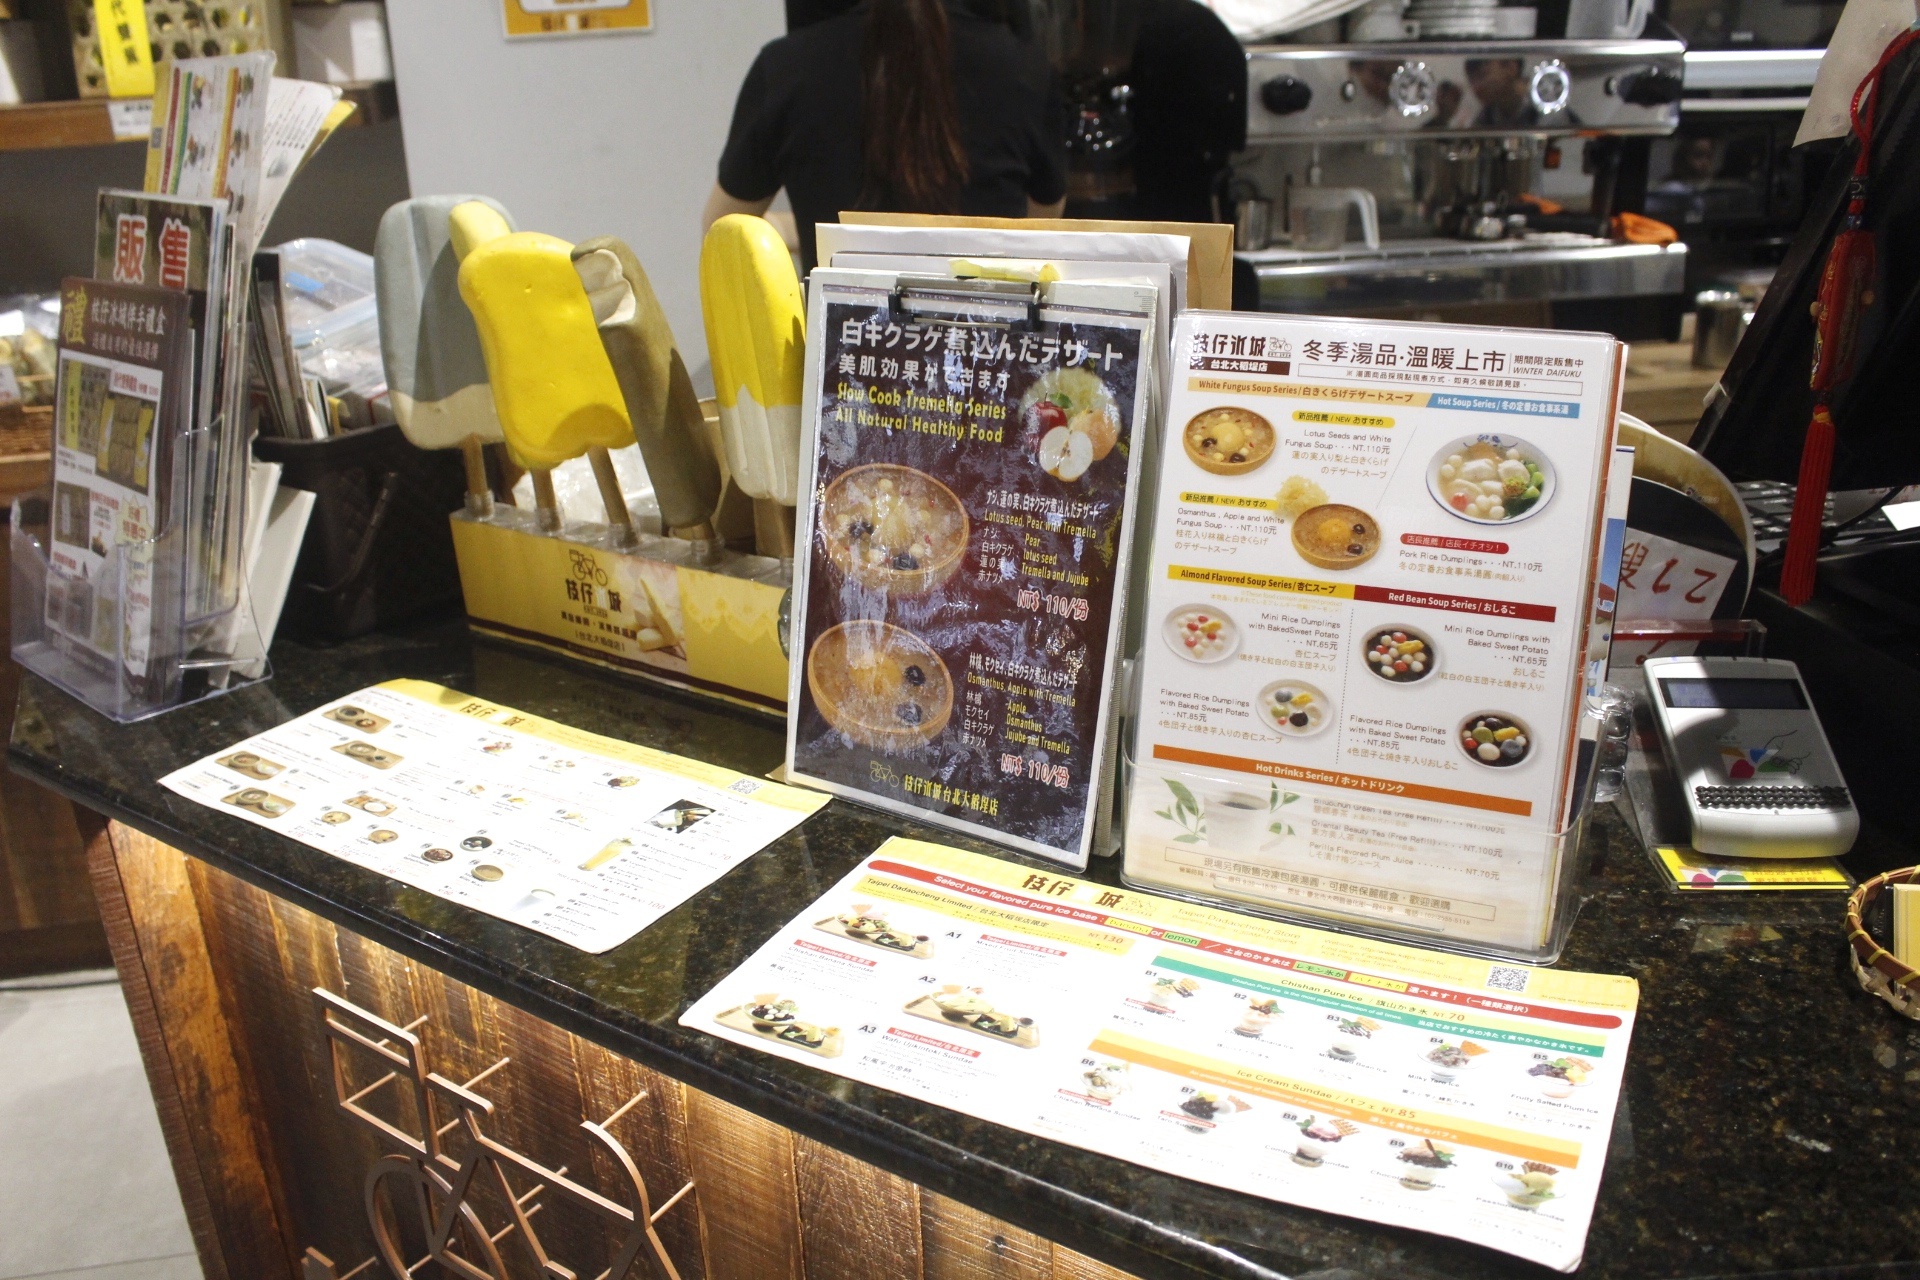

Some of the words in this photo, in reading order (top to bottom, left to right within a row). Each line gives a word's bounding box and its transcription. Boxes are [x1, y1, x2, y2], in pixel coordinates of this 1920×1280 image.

[1513, 367, 1543, 375] WINTER
[1546, 369, 1581, 378] DAIFUKU
[1199, 380, 1222, 390] White
[1223, 382, 1250, 393] Fungus
[1252, 384, 1272, 396] Soup
[1274, 385, 1297, 395] Series
[837, 381, 864, 401] Slow
[868, 385, 901, 405] Cook
[906, 390, 963, 415] Tremella
[968, 398, 1007, 420] Series
[1438, 397, 1451, 405] Hot
[1453, 398, 1471, 408] Soup
[1473, 399, 1495, 408] Series
[835, 407, 853, 422] All
[857, 411, 908, 431] Natural
[912, 416, 964, 442] Healthy
[970, 426, 1003, 443] Food
[1353, 417, 1384, 426] おすすめ
[1285, 439, 1311, 449] Fungus
[1314, 441, 1333, 450] Soup
[1304, 430, 1326, 438] Lotus
[1328, 431, 1350, 440] Seeds
[1353, 433, 1367, 442] and
[1369, 434, 1391, 443] White
[1237, 497, 1267, 508] おすすめ
[984, 508, 1004, 523] Lotus
[1026, 516, 1043, 529] Pear
[1063, 520, 1097, 539] Tremella
[1177, 518, 1202, 528] Fungus
[1204, 520, 1222, 529] Soup
[1178, 508, 1216, 518] Osmanthus
[1224, 512, 1246, 522] Apple
[1248, 514, 1261, 522] and
[1263, 515, 1285, 524] White
[1025, 533, 1041, 547] Pear
[1023, 548, 1039, 561] lotus
[1041, 552, 1058, 564] seed
[1400, 550, 1417, 559] Pork
[1420, 551, 1438, 560] Rice
[1441, 554, 1482, 566] Dumplings
[1021, 562, 1051, 579] Tremella
[1052, 569, 1065, 582] and
[1066, 570, 1089, 587] Jujube
[1181, 569, 1210, 581] Almond
[1212, 572, 1245, 584] Flavored
[1247, 576, 1267, 588] Soup
[1269, 578, 1292, 590] Series
[1388, 593, 1405, 602] Red
[1406, 594, 1427, 605] Bean
[1428, 597, 1449, 608] Soup
[1451, 600, 1477, 611] Series
[1484, 603, 1516, 615] おしるこ
[1261, 613, 1280, 622] Mini
[1281, 615, 1299, 624] Rice
[1301, 617, 1341, 629] Dumplings
[1249, 622, 1265, 630] with
[1314, 630, 1340, 639] Potato
[1444, 625, 1464, 634] Mini
[1466, 627, 1484, 636] Rice
[1486, 629, 1529, 642] Dumplings
[1532, 634, 1550, 644] with
[1468, 639, 1492, 649] Baked
[1495, 642, 1519, 652] Sweet
[1522, 645, 1549, 655] Potato
[1513, 668, 1545, 679] おしるこ
[1007, 680, 1027, 696] Apple
[1028, 685, 1044, 699] with
[1045, 689, 1076, 708] Tremella
[1160, 688, 1192, 699] Flavored
[1193, 692, 1210, 701] Rice
[1212, 694, 1250, 707] Dumplings
[461, 703, 526, 726] 枝仔城
[1007, 699, 1027, 714] Apple
[1160, 699, 1176, 707] with
[1178, 701, 1199, 711] Baked
[1201, 704, 1223, 714] Sweet
[1226, 707, 1249, 717] Potato
[1006, 713, 1043, 733] Osmanthus
[1350, 715, 1383, 726] Flavored
[1386, 719, 1403, 728] Rice
[1405, 721, 1447, 735] Dumplings
[1005, 727, 1027, 743] Jujube
[1027, 734, 1040, 747] and
[1041, 738, 1070, 755] Tremella
[1350, 726, 1365, 734] with
[1368, 728, 1391, 738] Baked
[1394, 731, 1418, 742] Sweet
[1420, 735, 1445, 746] Potato
[1256, 763, 1272, 774] Hot
[1274, 766, 1304, 778] Drinks
[1306, 771, 1333, 782] Series
[1341, 777, 1405, 793] ホットドリンク
[1311, 820, 1342, 831] Oriental
[1344, 825, 1368, 836] Beauty
[1372, 830, 1385, 838] Tea
[1336, 845, 1368, 858] Flavored
[1372, 851, 1391, 861] Plum
[1393, 856, 1414, 865] Juice
[864, 878, 892, 887] Taipei
[890, 884, 944, 901] Dadaocheng
[938, 898, 974, 909] Limited
[1022, 874, 1124, 908] 枝仔城
[933, 874, 964, 888] Select
[966, 884, 990, 895] your
[988, 891, 1029, 905] flavored
[1028, 901, 1054, 911] pure
[1053, 906, 1072, 914] ice
[1071, 910, 1099, 920] base
[1106, 918, 1151, 932] banana
[1162, 932, 1199, 944] lemon
[945, 930, 962, 938] A1
[917, 974, 937, 983] A2
[1279, 979, 1321, 992] Chishan
[1322, 988, 1346, 997] Pure
[1236, 1069, 1253, 1078] Ice
[1254, 1074, 1290, 1087] Cream
[1291, 1083, 1333, 1098] Sundae
[857, 1024, 878, 1034] A3
[1080, 1058, 1096, 1066] B6
[1180, 1086, 1195, 1094] B7
[1281, 1112, 1297, 1121] B8
[1494, 1160, 1514, 1171] B10
